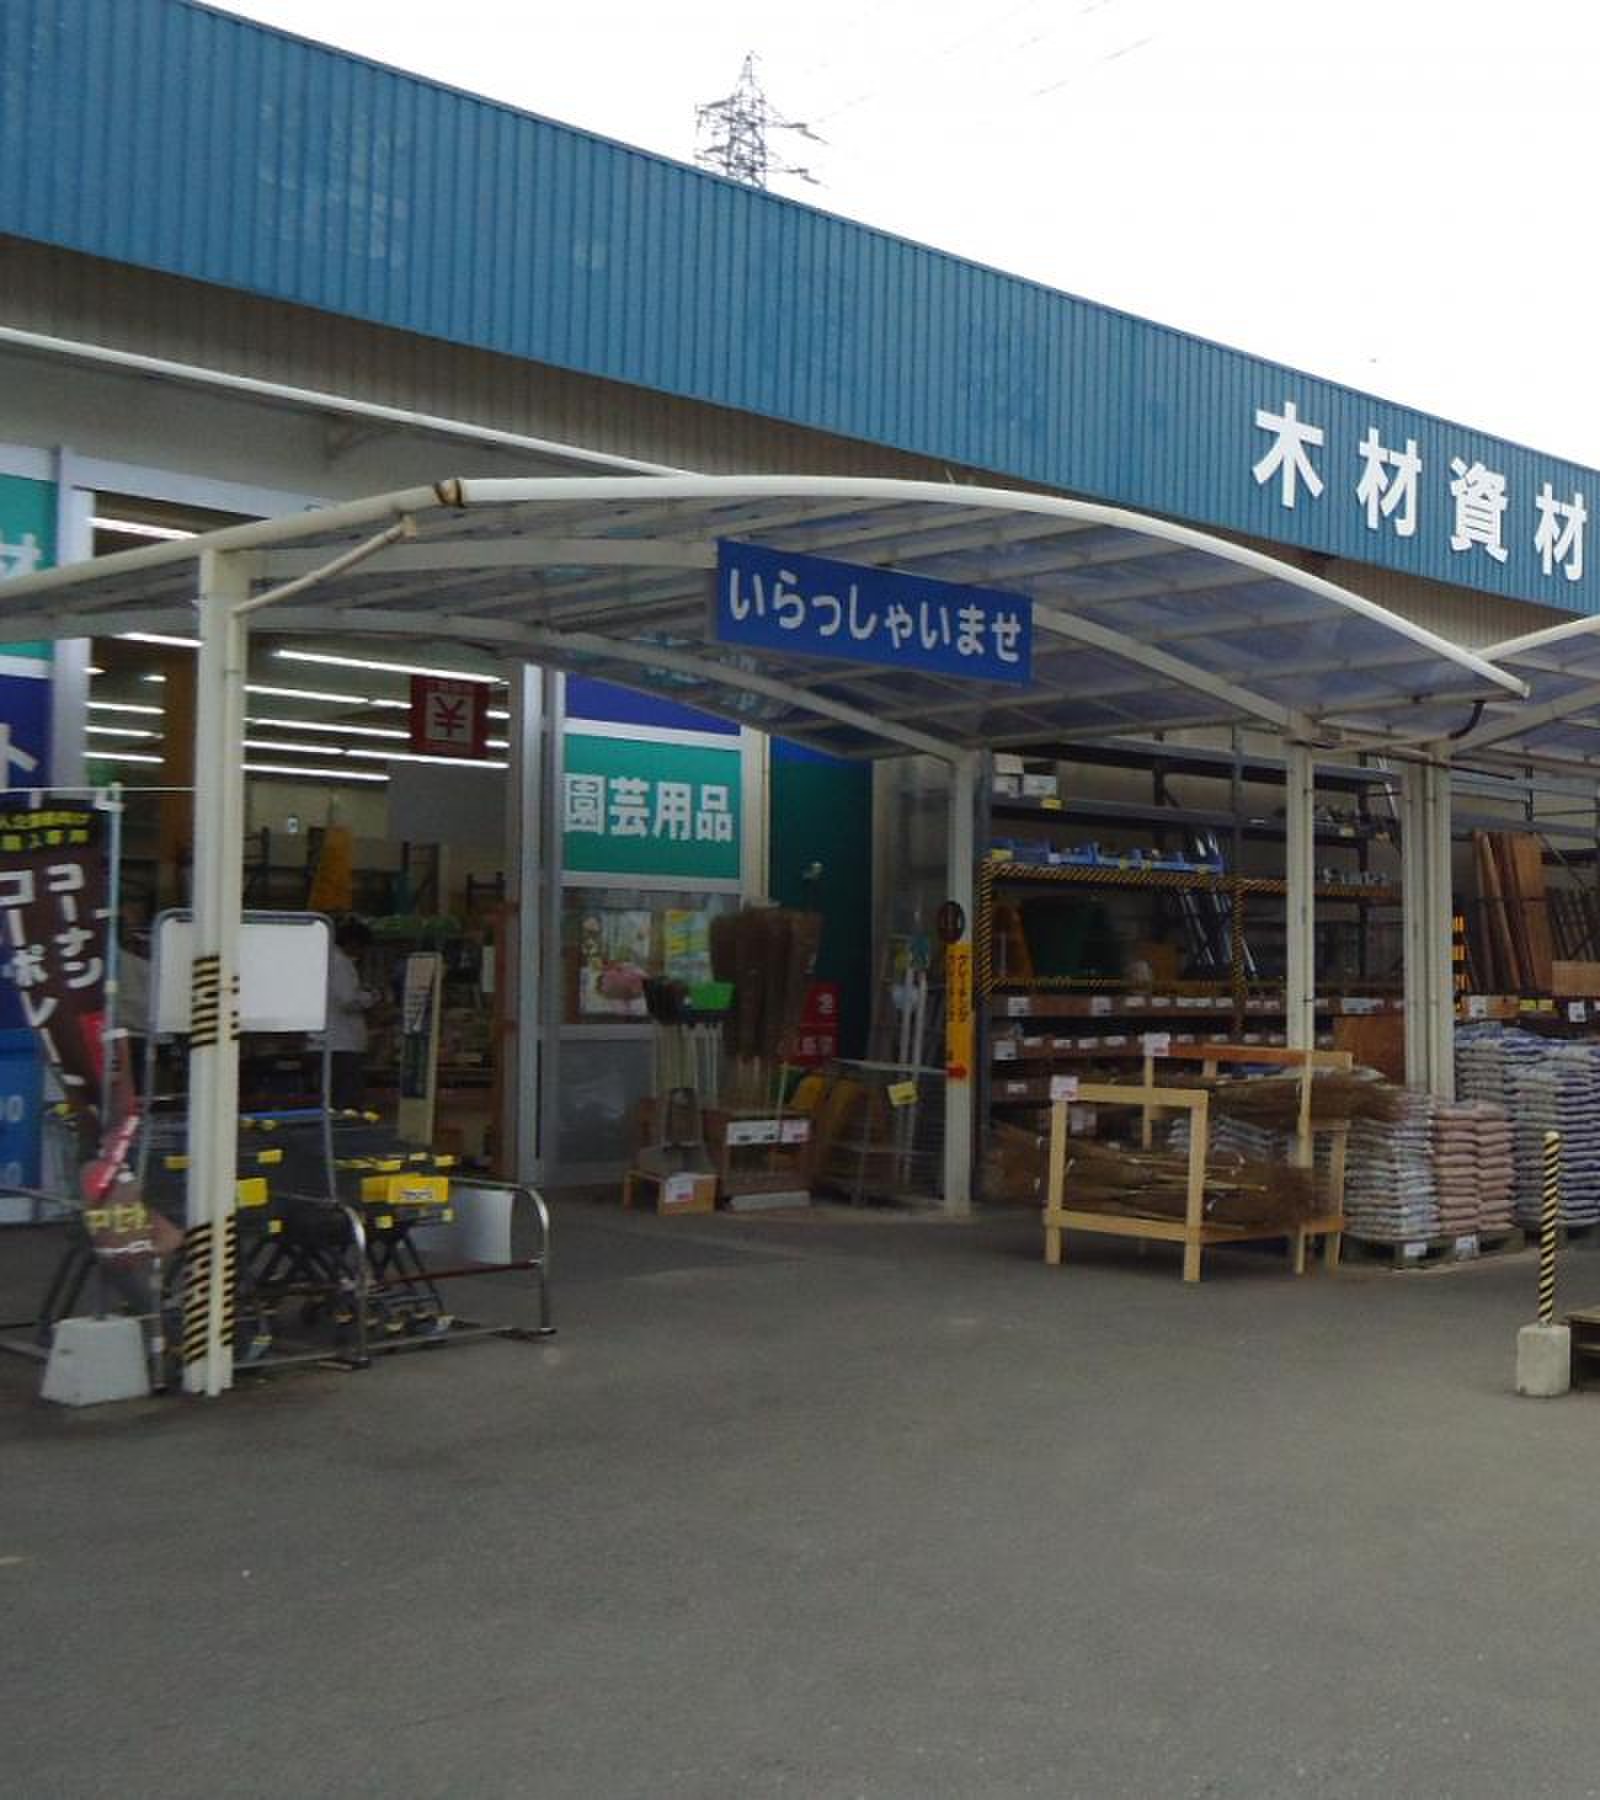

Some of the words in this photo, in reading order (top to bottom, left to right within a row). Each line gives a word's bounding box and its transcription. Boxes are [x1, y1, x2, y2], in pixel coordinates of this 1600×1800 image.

[729, 568, 1022, 664] いらっしゃいませ
[563, 773, 733, 842] 園芸用品
[46, 863, 103, 989] コーナン
